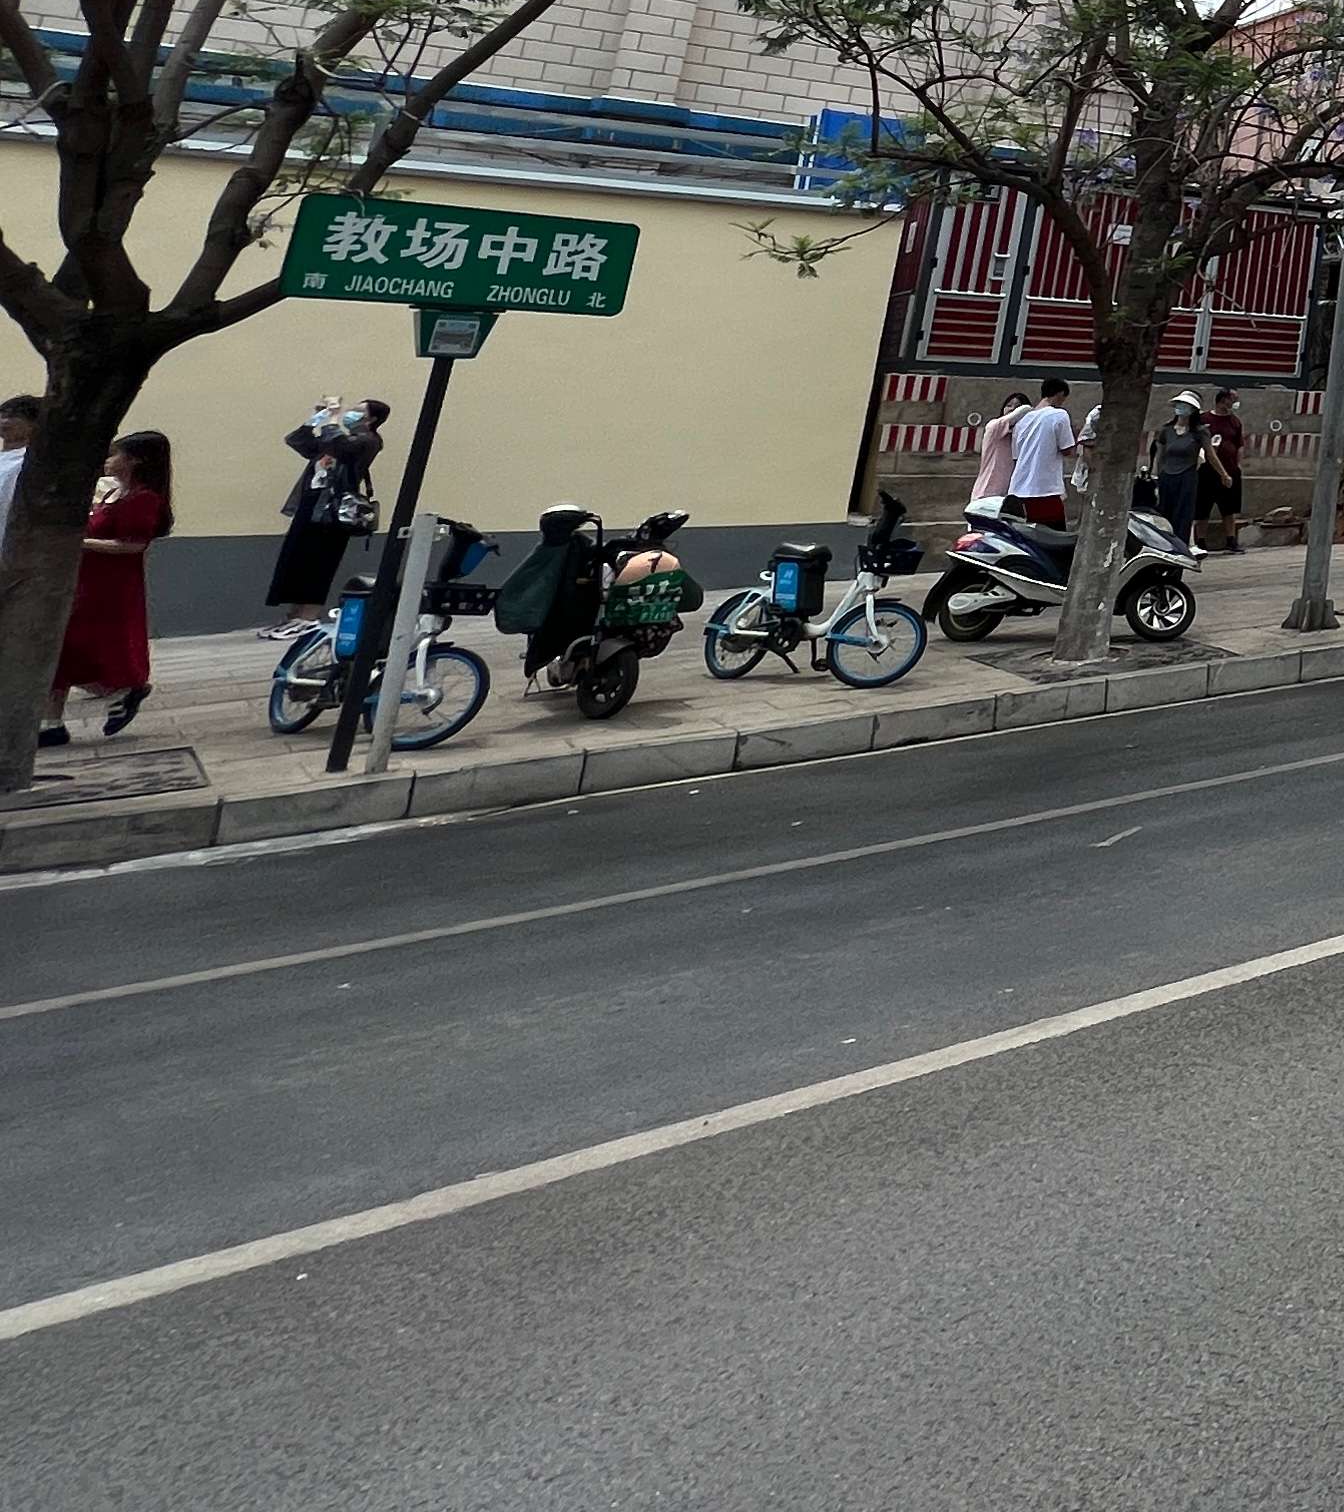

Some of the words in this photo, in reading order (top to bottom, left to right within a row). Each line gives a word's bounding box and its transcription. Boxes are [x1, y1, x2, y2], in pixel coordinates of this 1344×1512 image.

[322, 211, 609, 282] 教场中路
[302, 271, 329, 290] 南
[344, 274, 455, 299] JIAOCHANG
[486, 284, 571, 307] ZHONGLU
[585, 291, 607, 309] 北
